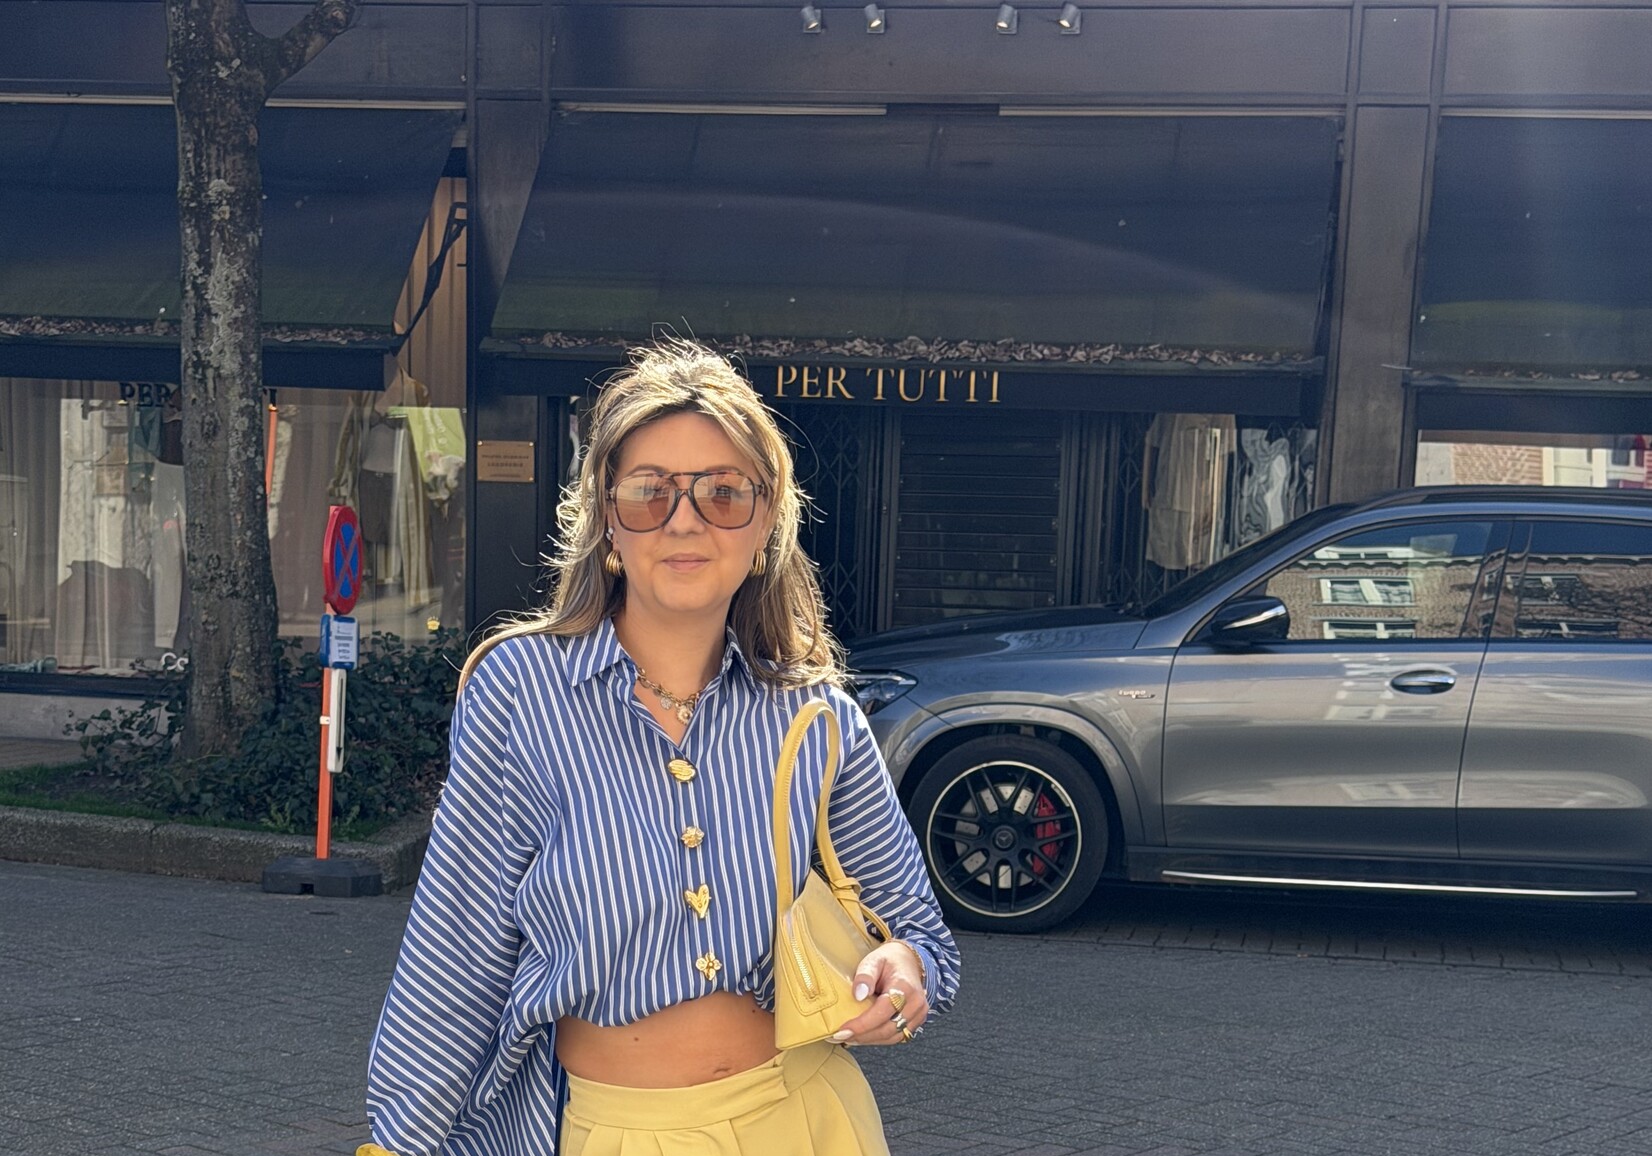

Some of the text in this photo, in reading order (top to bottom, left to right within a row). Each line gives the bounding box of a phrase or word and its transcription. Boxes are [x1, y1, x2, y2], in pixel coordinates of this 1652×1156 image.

[119, 382, 176, 407] PER
[774, 364, 1001, 403] PER TUTTI
